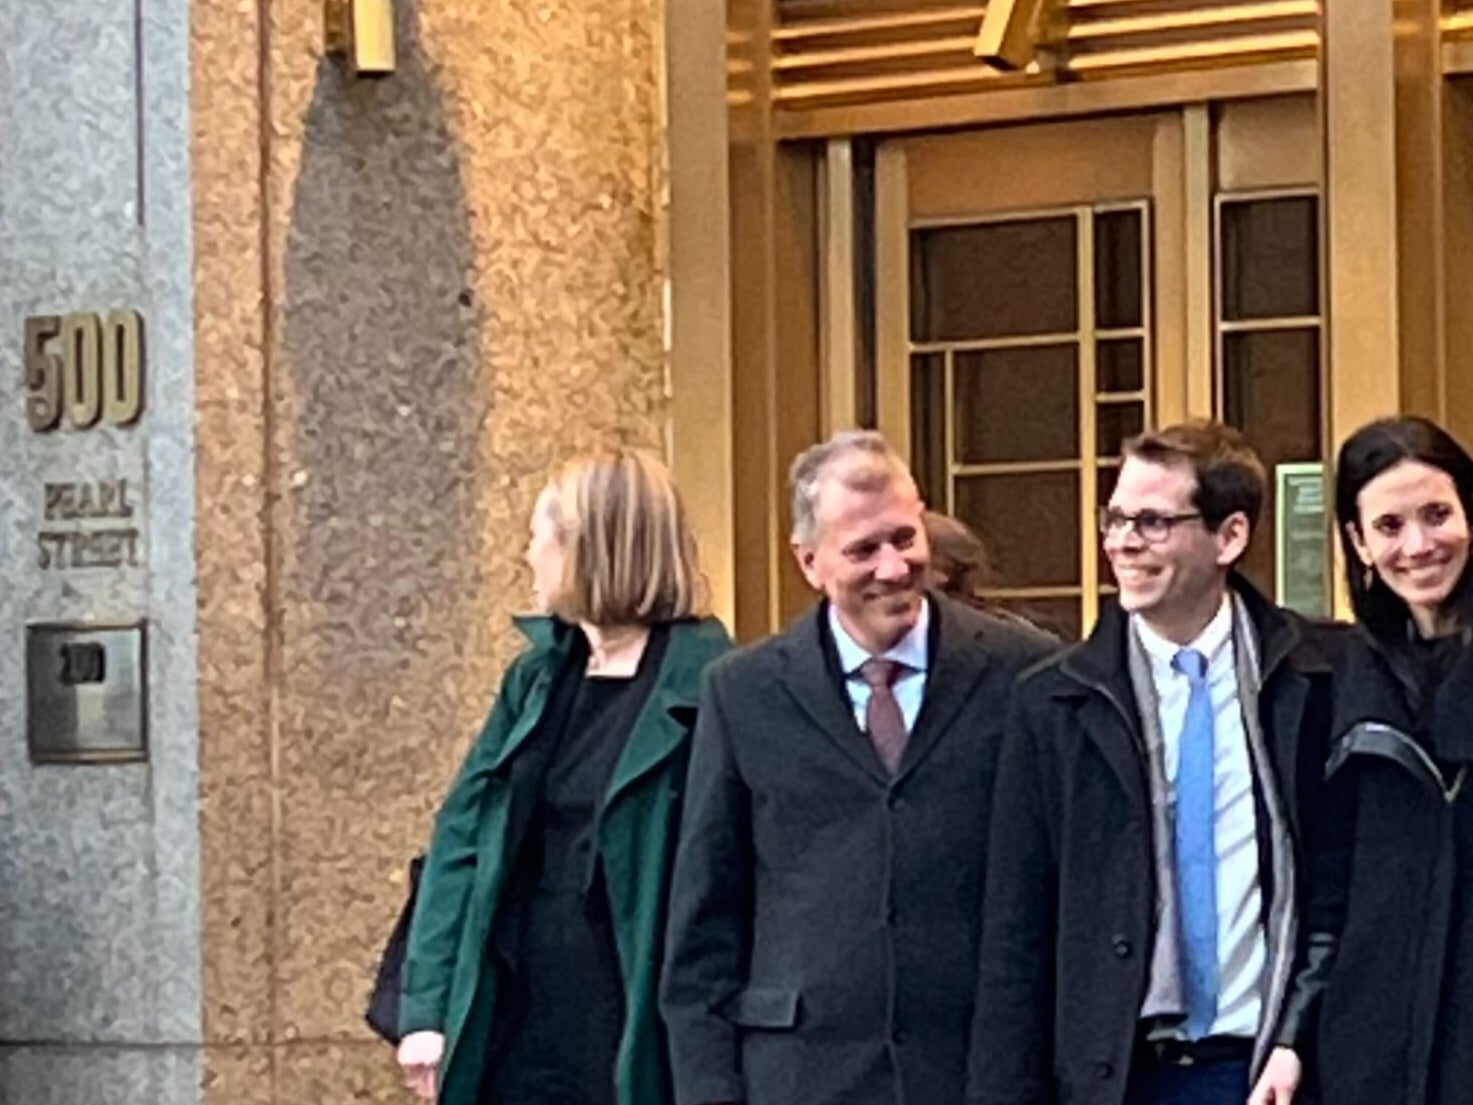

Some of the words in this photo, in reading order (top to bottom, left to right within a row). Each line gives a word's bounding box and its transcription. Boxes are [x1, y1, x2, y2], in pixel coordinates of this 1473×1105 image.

[25, 308, 145, 434] 500
[44, 479, 133, 520] PEARL
[38, 529, 139, 570] STREET
